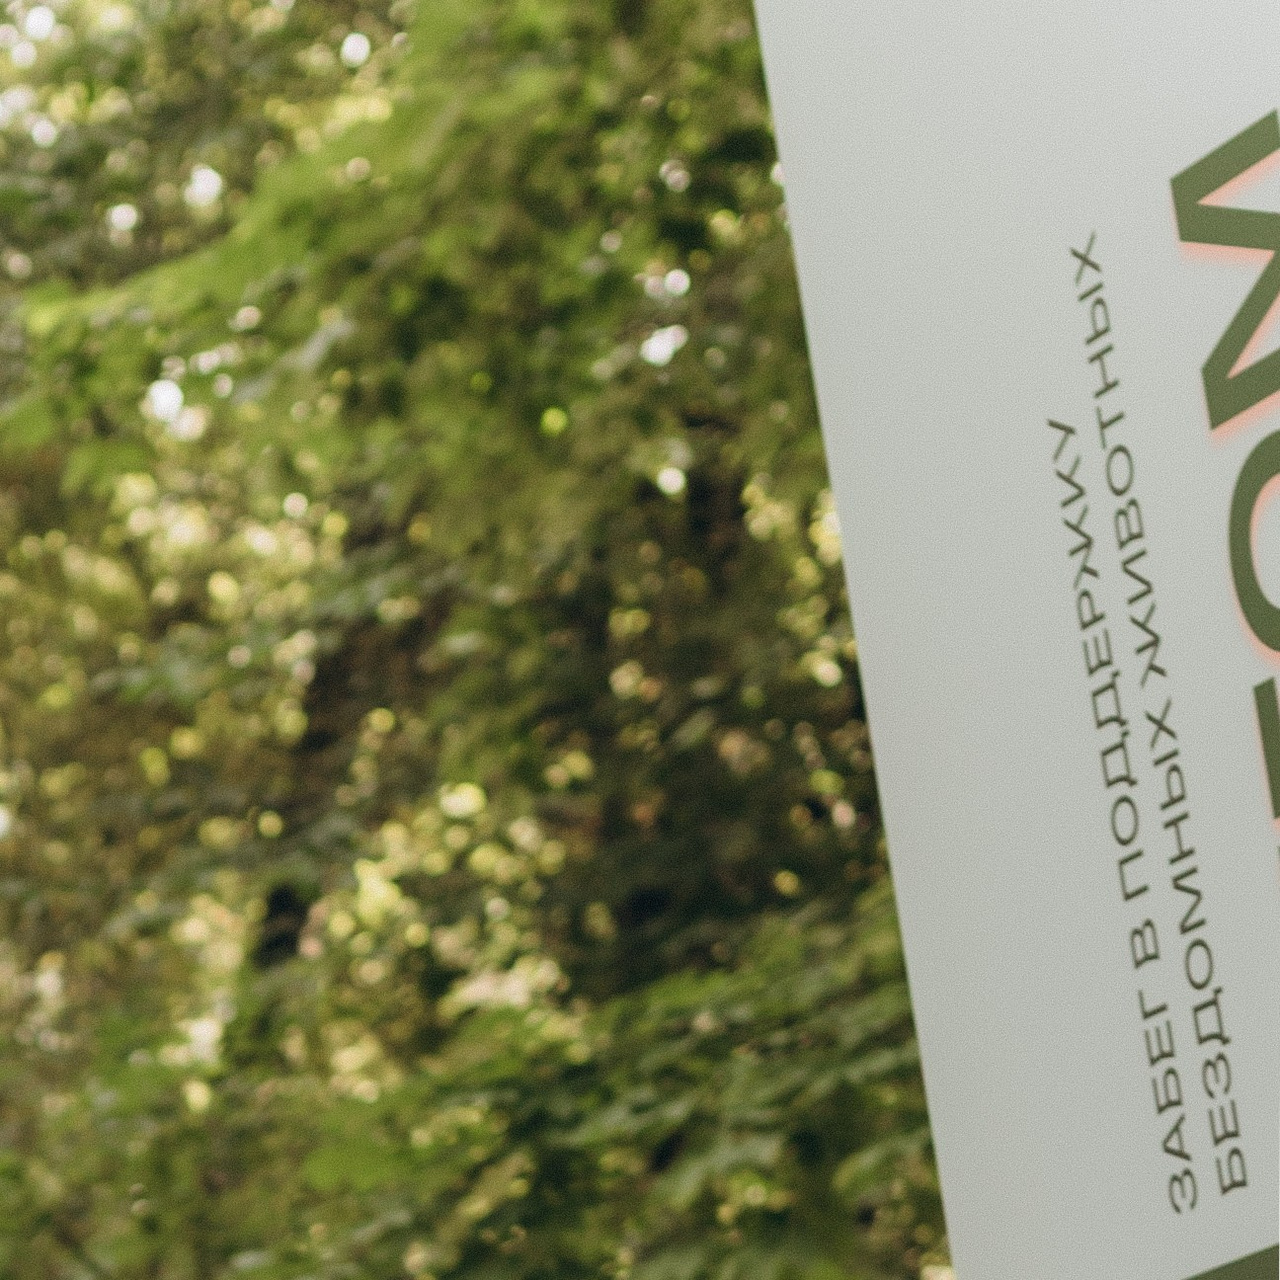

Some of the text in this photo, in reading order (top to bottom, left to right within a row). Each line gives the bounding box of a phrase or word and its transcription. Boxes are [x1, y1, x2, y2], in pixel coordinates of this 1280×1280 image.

[1068, 230, 1168, 689] ЖИВОТНЫХ
[1046, 417, 1198, 1214] ЗАБЕГ В ПОДДЕРЖКУ
[1145, 697, 1249, 1196] БЕЗДОМНЫХ
